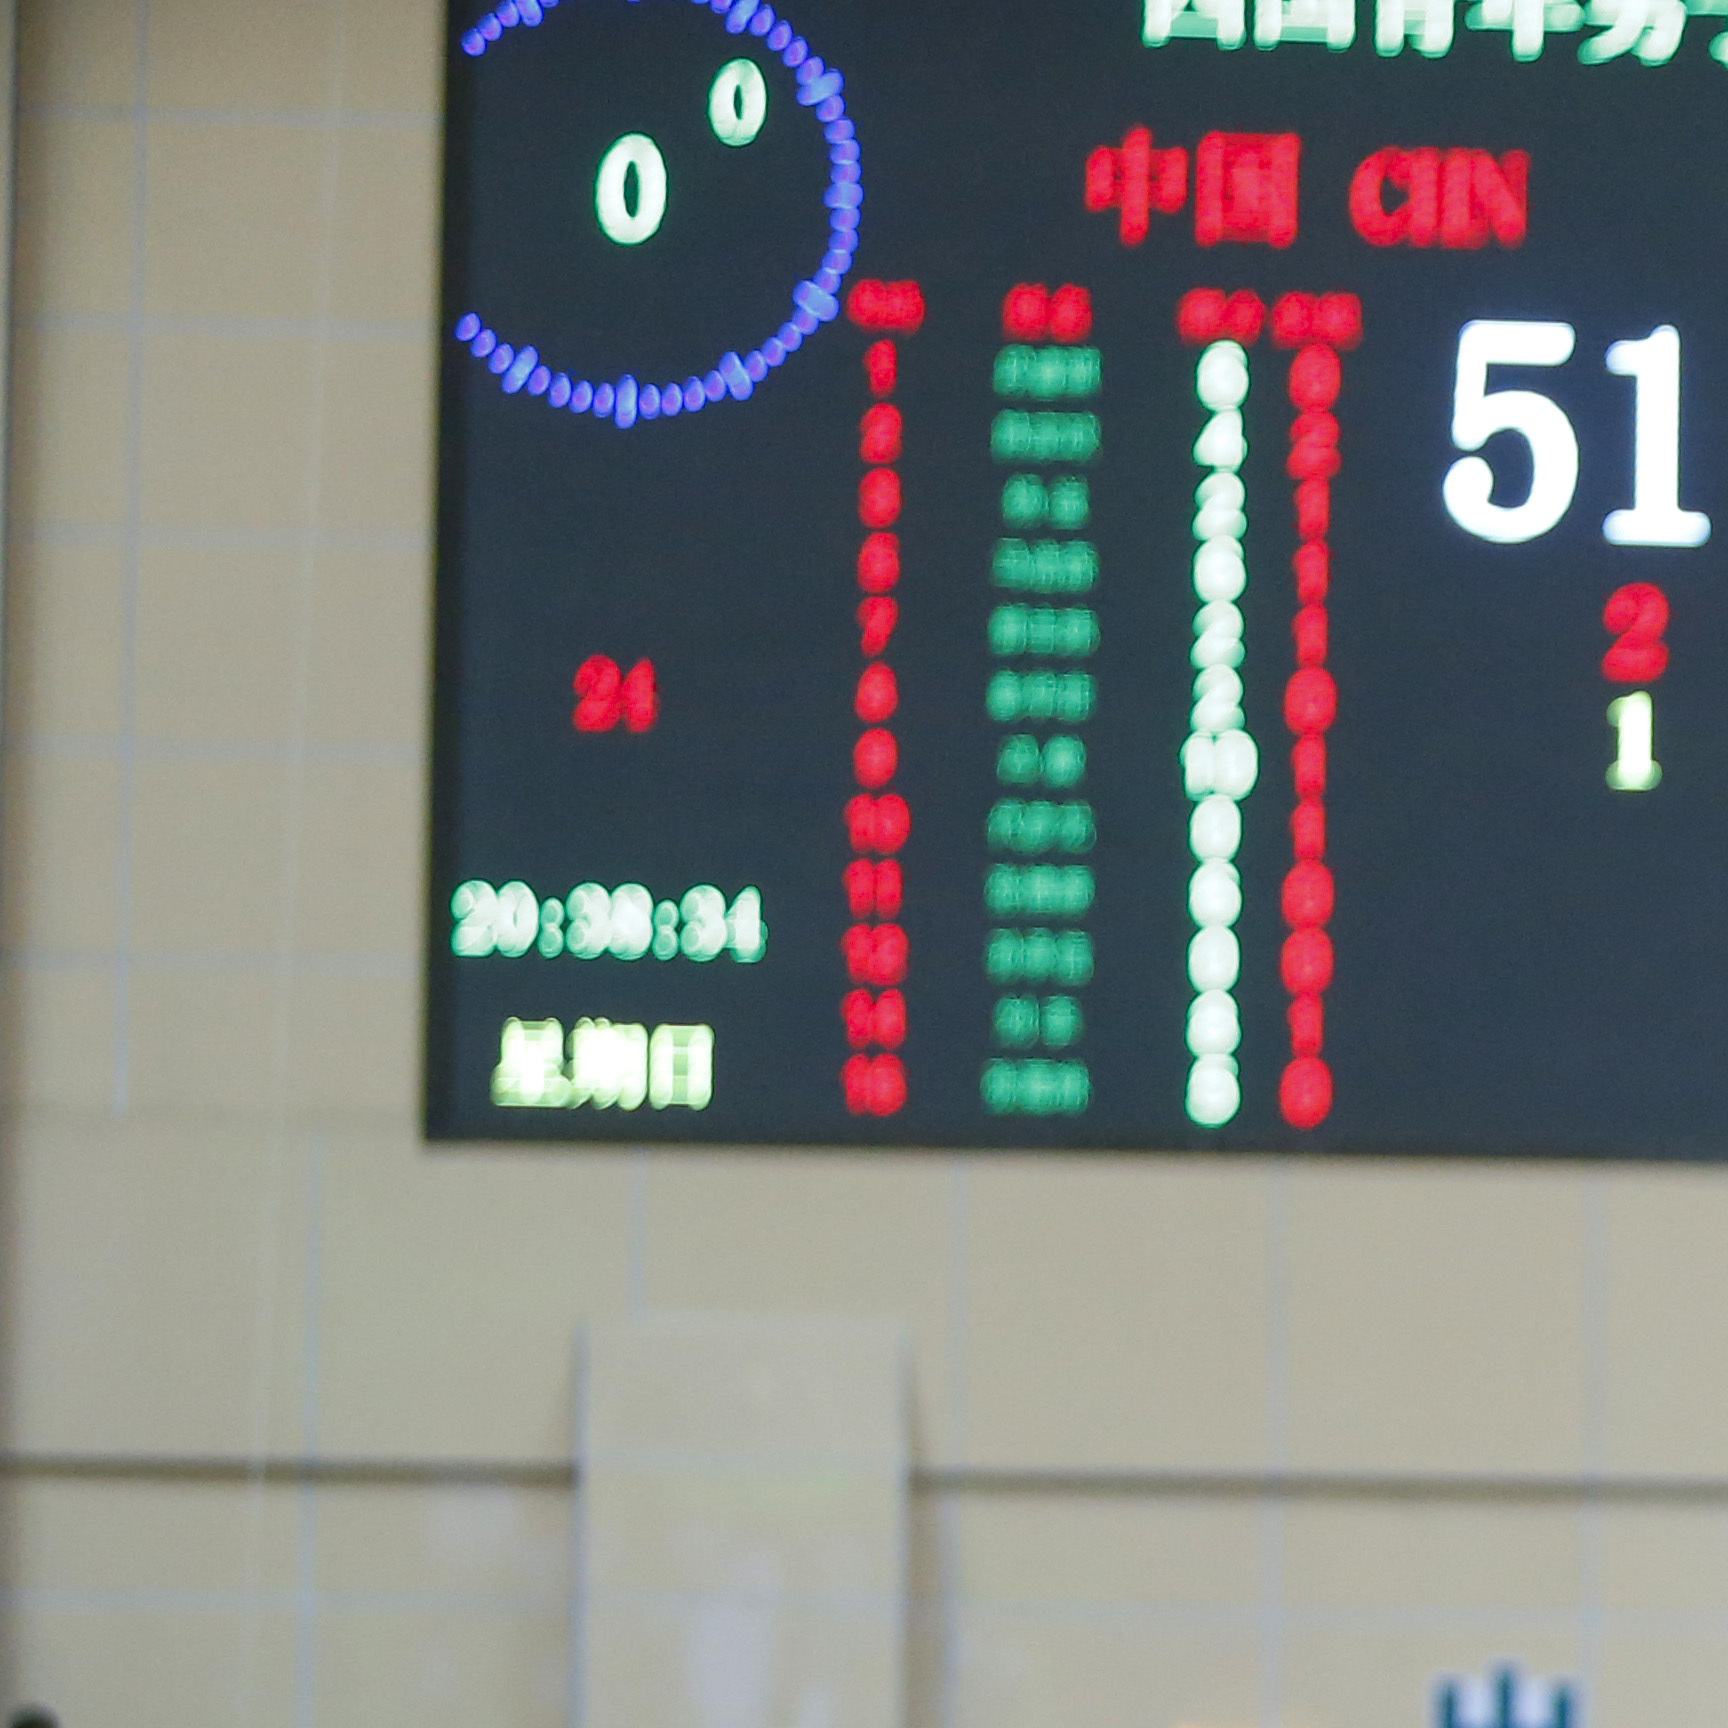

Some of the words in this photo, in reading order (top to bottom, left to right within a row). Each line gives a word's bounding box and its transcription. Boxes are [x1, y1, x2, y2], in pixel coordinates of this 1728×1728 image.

[708, 58, 767, 146] 0
[596, 132, 667, 245] 0
[1085, 124, 1300, 249] 中国
[1443, 319, 1712, 548] 51
[1603, 581, 1669, 683] 2
[1606, 691, 1663, 790] 1
